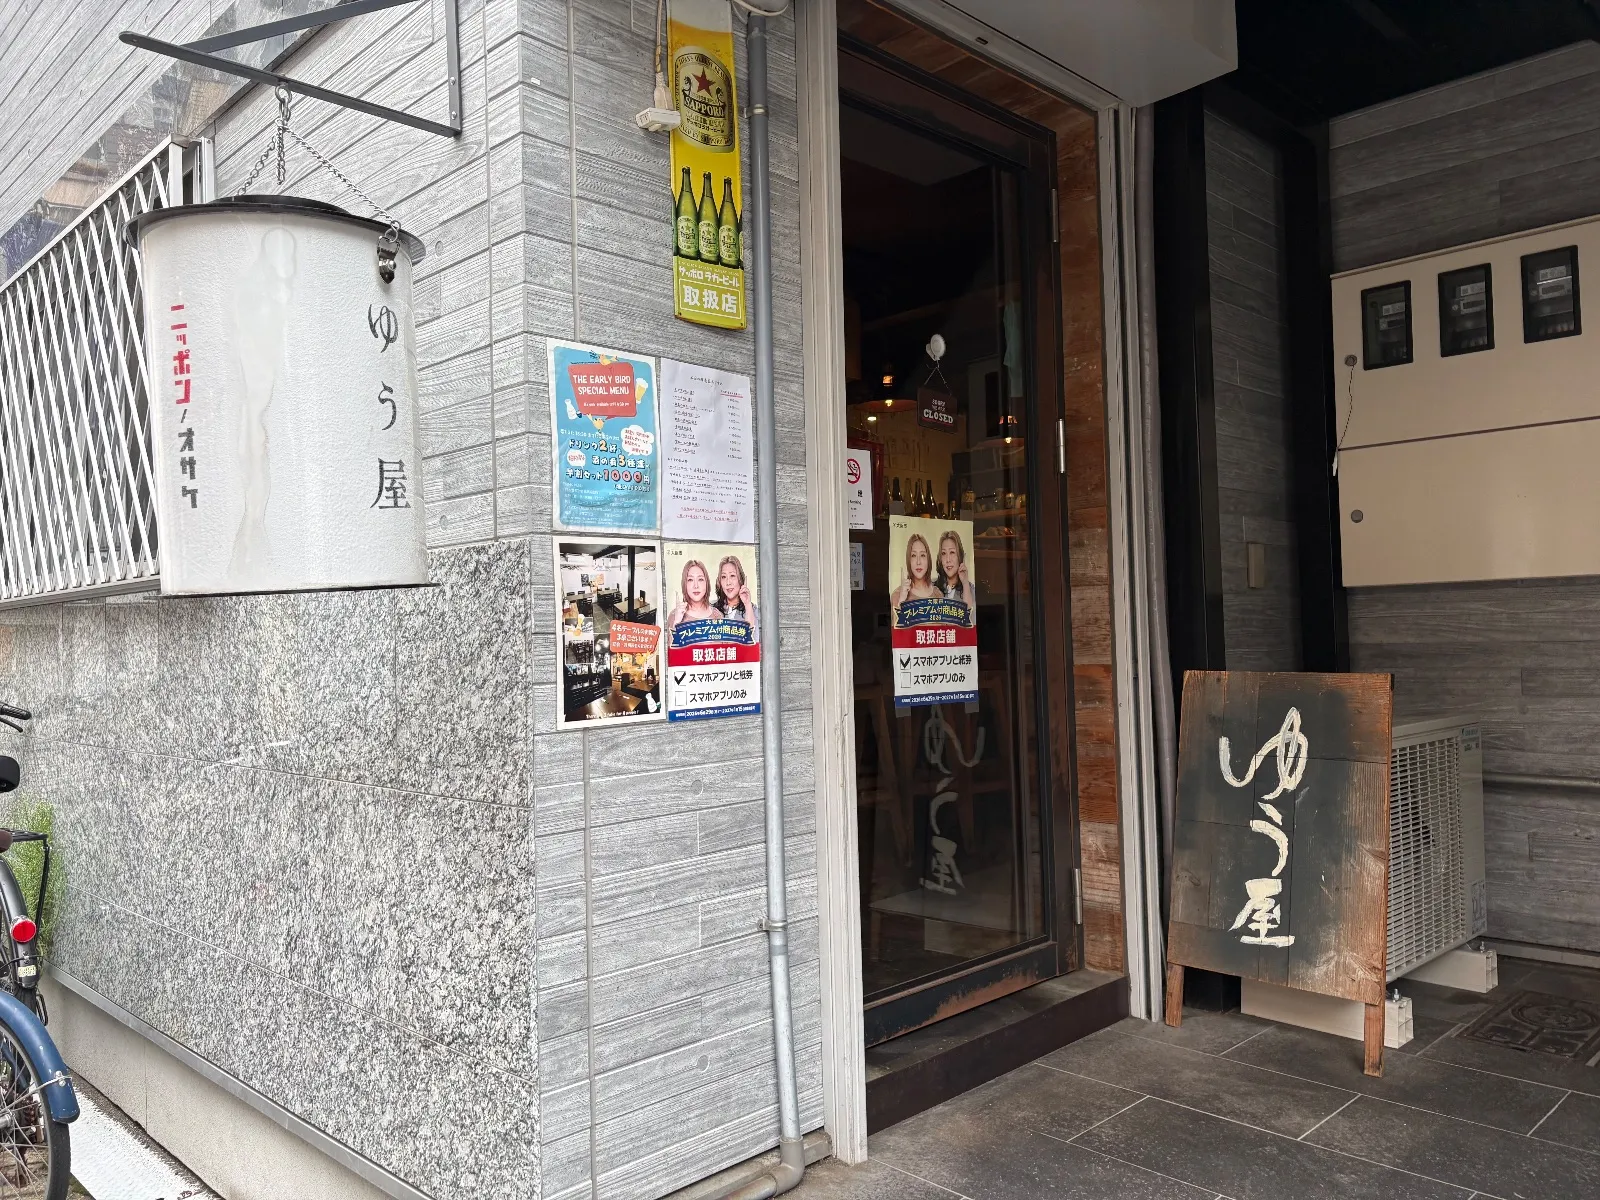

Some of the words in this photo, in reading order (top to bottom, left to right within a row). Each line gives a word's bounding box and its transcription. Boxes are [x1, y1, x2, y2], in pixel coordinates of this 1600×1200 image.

[684, 96, 724, 117] SAPPORO
[678, 266, 704, 280] サッポロ
[705, 272, 740, 287] ラガービール
[682, 284, 738, 314] 取扱店
[573, 374, 588, 384] THE
[590, 375, 612, 384] EARLY
[615, 376, 631, 384] BIRD
[578, 386, 608, 395] SPECIAL
[610, 386, 630, 395] MENU
[367, 303, 412, 510] ゆう屋
[923, 409, 954, 424] CLOSED
[903, 605, 965, 619] プレミアム付商品券
[679, 625, 746, 639] プレミアム付商品券
[915, 629, 957, 644] 取扱店舗
[692, 647, 737, 662] 取扱店舗
[913, 654, 972, 667] スマホアプリと紙券
[689, 669, 753, 684] スマホアプリと紙券
[913, 672, 966, 685] スマホアプリのみ
[689, 689, 748, 703] スマホアプリのみ
[1219, 706, 1309, 948] ゆう屋
